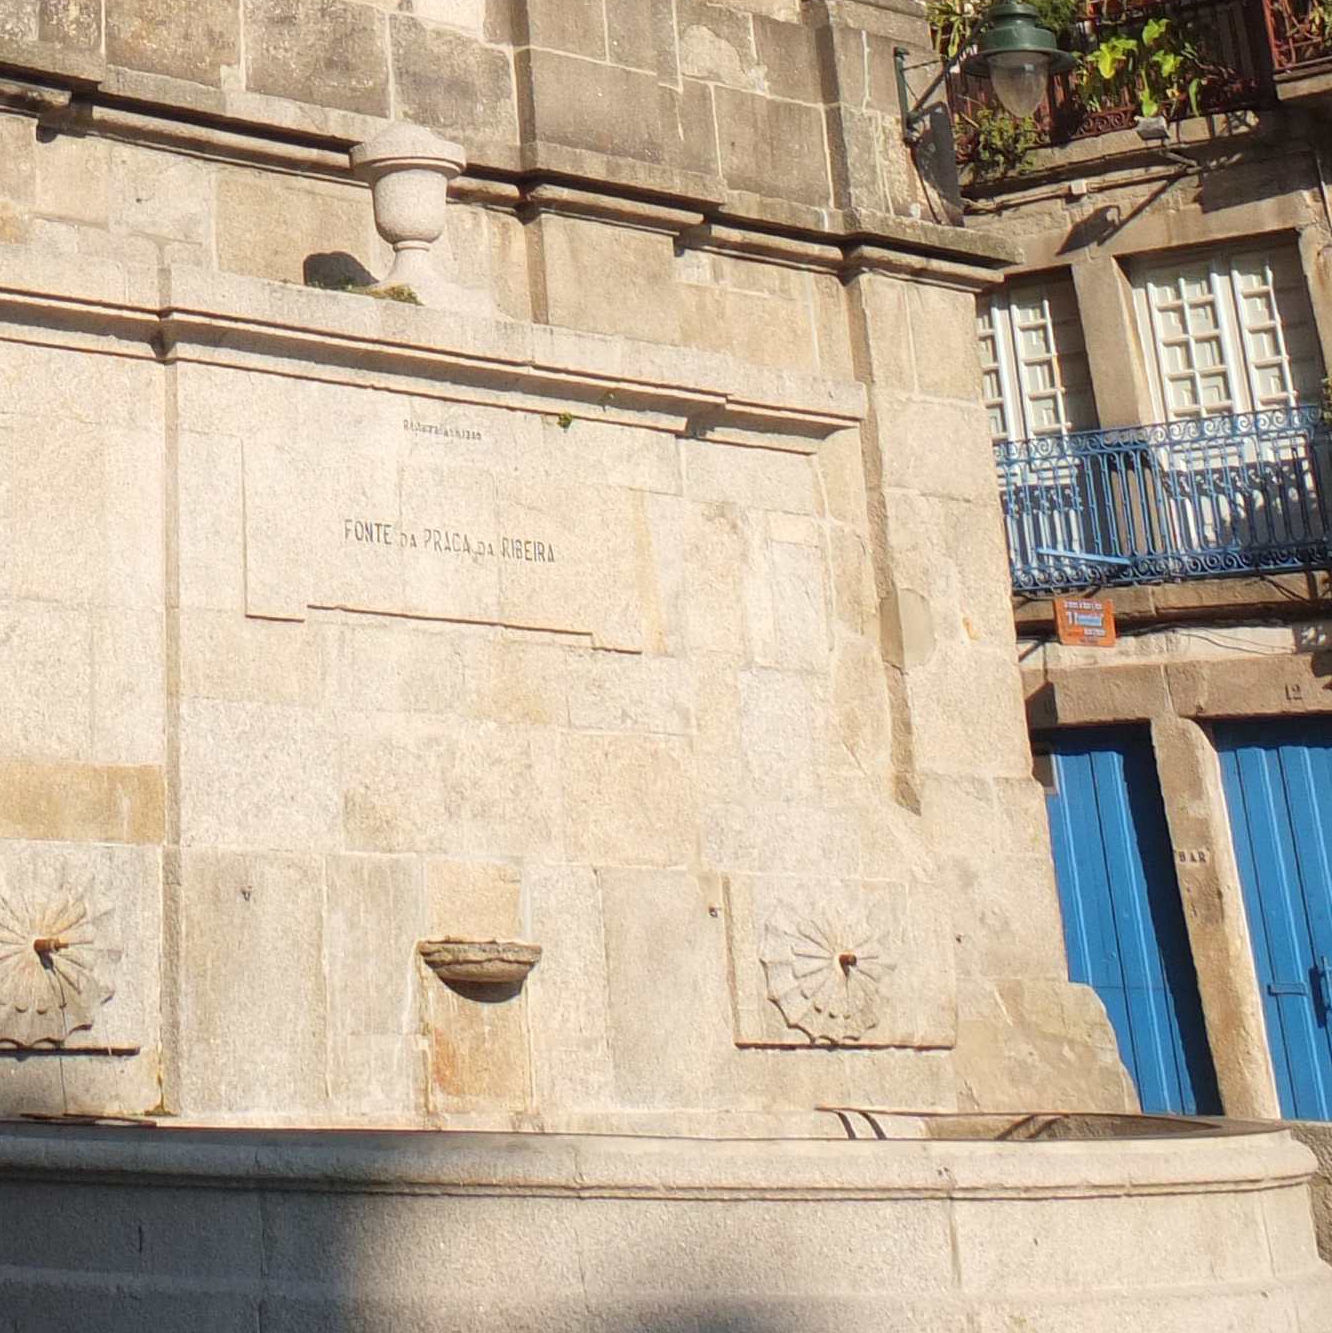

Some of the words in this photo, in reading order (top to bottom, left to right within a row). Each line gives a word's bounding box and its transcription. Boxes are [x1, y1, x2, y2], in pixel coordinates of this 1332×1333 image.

[345, 519, 392, 545] FONTE
[400, 532, 417, 548] DA
[478, 541, 494, 556] DA
[502, 537, 555, 563] RIBEIRA
